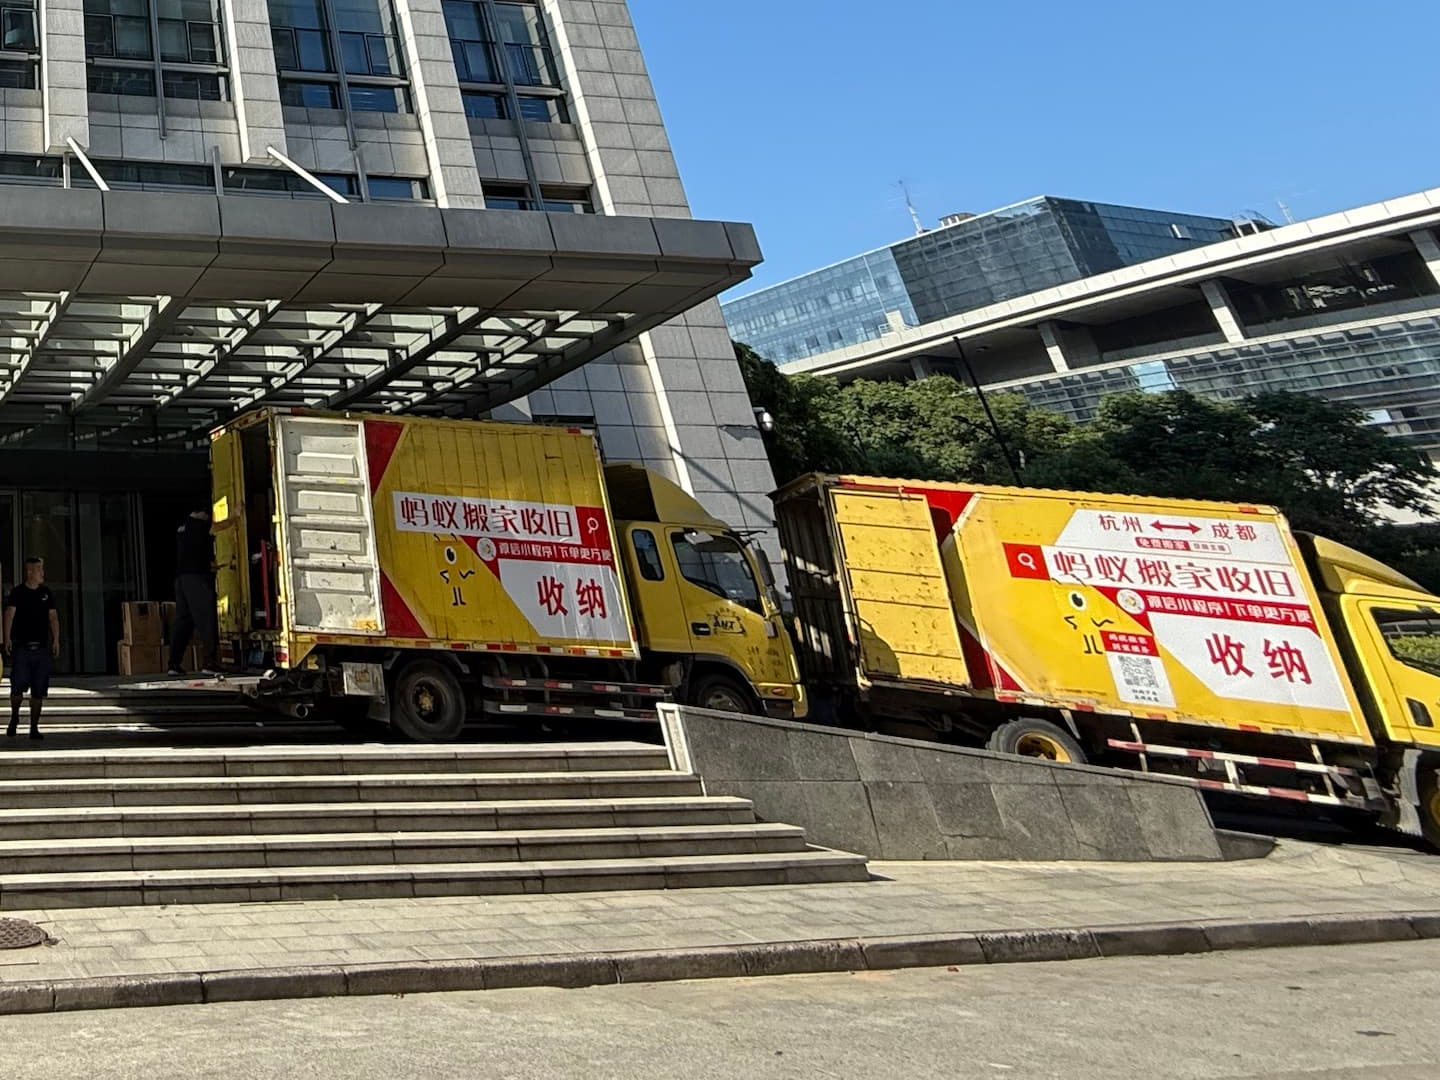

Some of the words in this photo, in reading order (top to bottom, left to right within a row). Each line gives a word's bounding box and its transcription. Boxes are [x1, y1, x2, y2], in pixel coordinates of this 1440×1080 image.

[400, 496, 573, 537] 蚂蚁搬家收旧
[1098, 514, 1144, 534] 杭州
[1212, 522, 1257, 542] 成都
[1053, 550, 1296, 598] 蚂蚁搬家收旧
[536, 575, 607, 619] 收纳
[1205, 633, 1312, 685] 收纳
